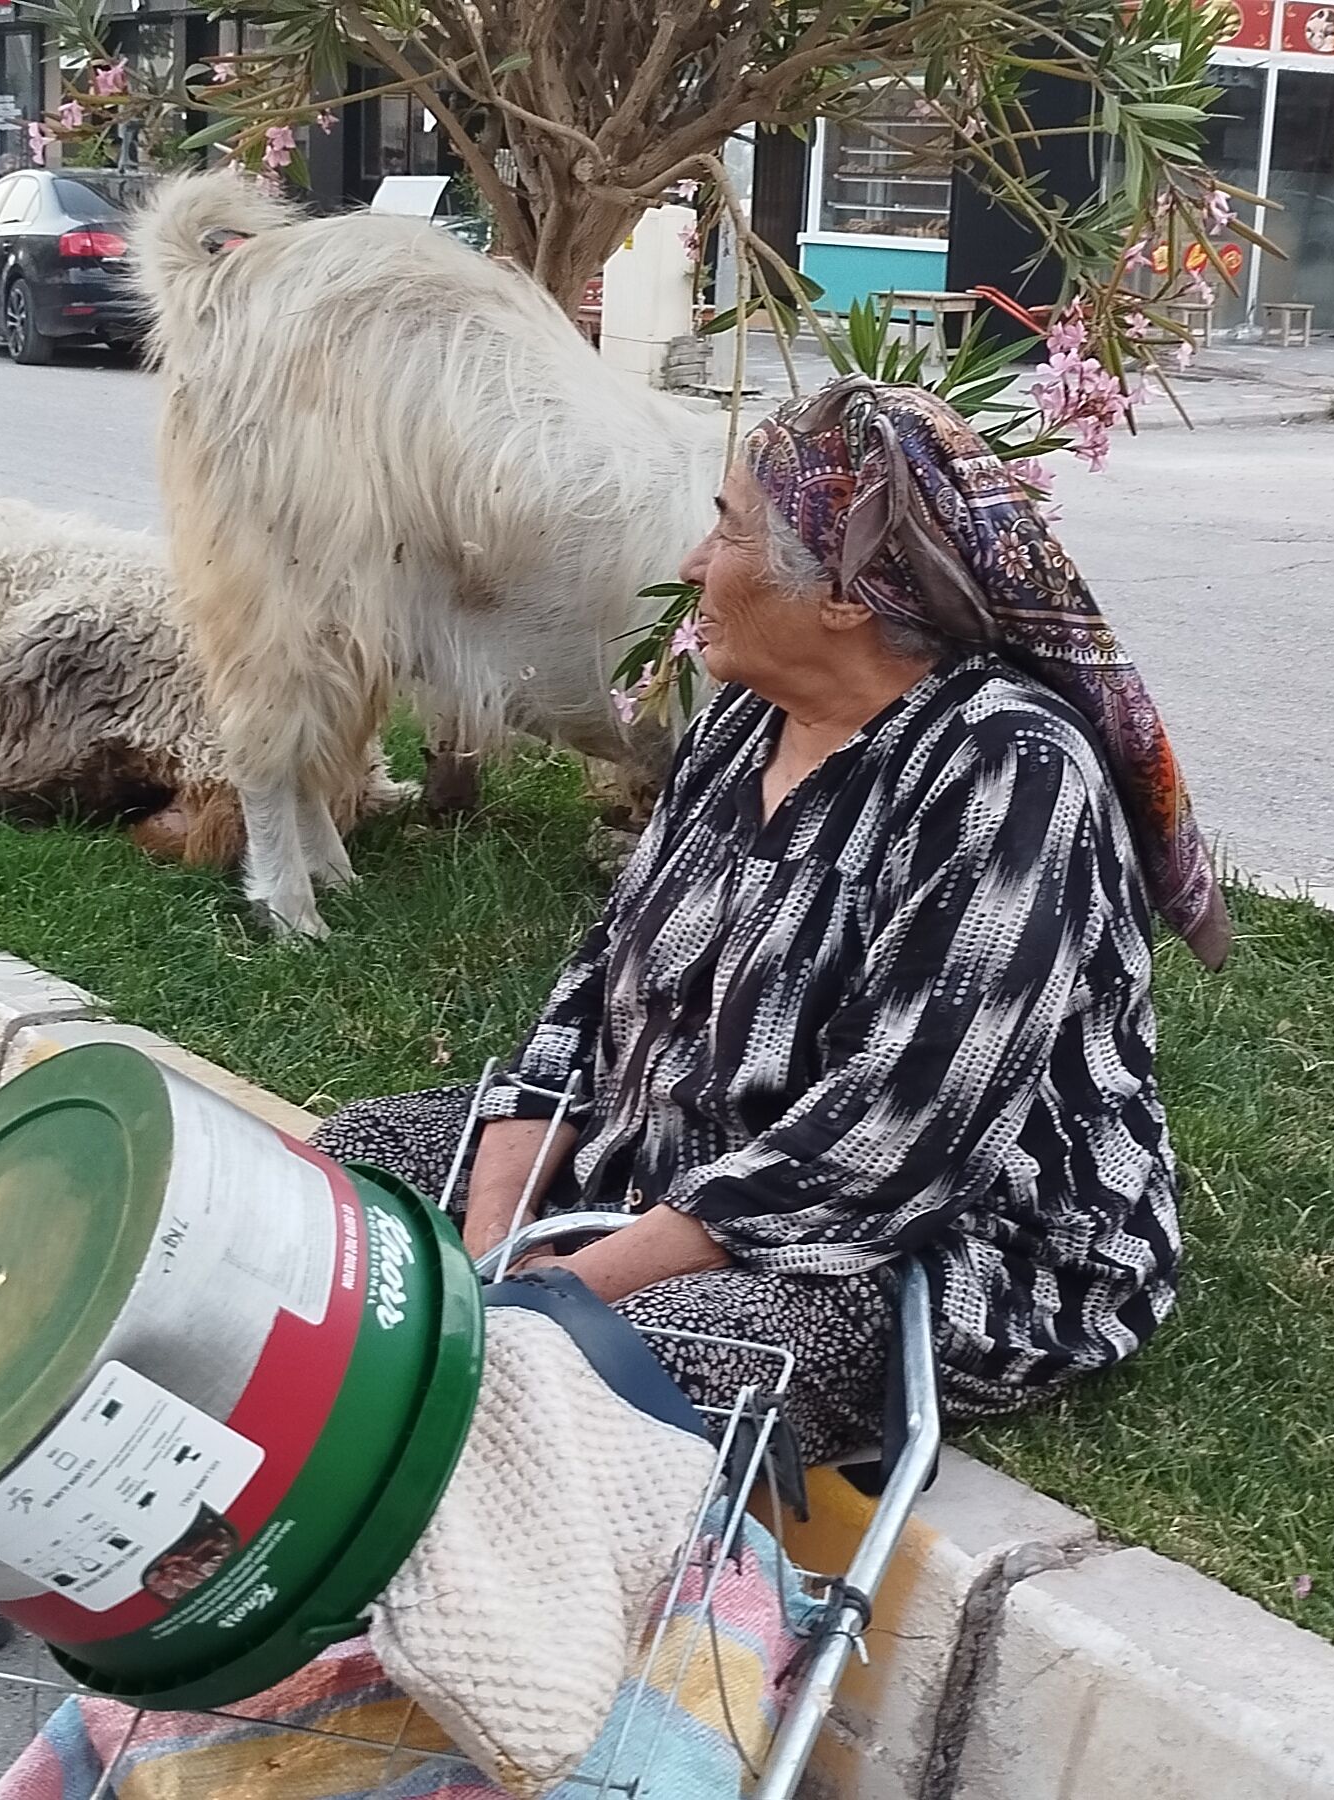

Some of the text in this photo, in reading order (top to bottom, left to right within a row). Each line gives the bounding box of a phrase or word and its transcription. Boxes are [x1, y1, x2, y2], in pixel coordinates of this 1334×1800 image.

[365, 1206, 381, 1304] PROFESSIONAL
[372, 1205, 415, 1329] Knorr
[217, 1582, 279, 1629] Knorr
